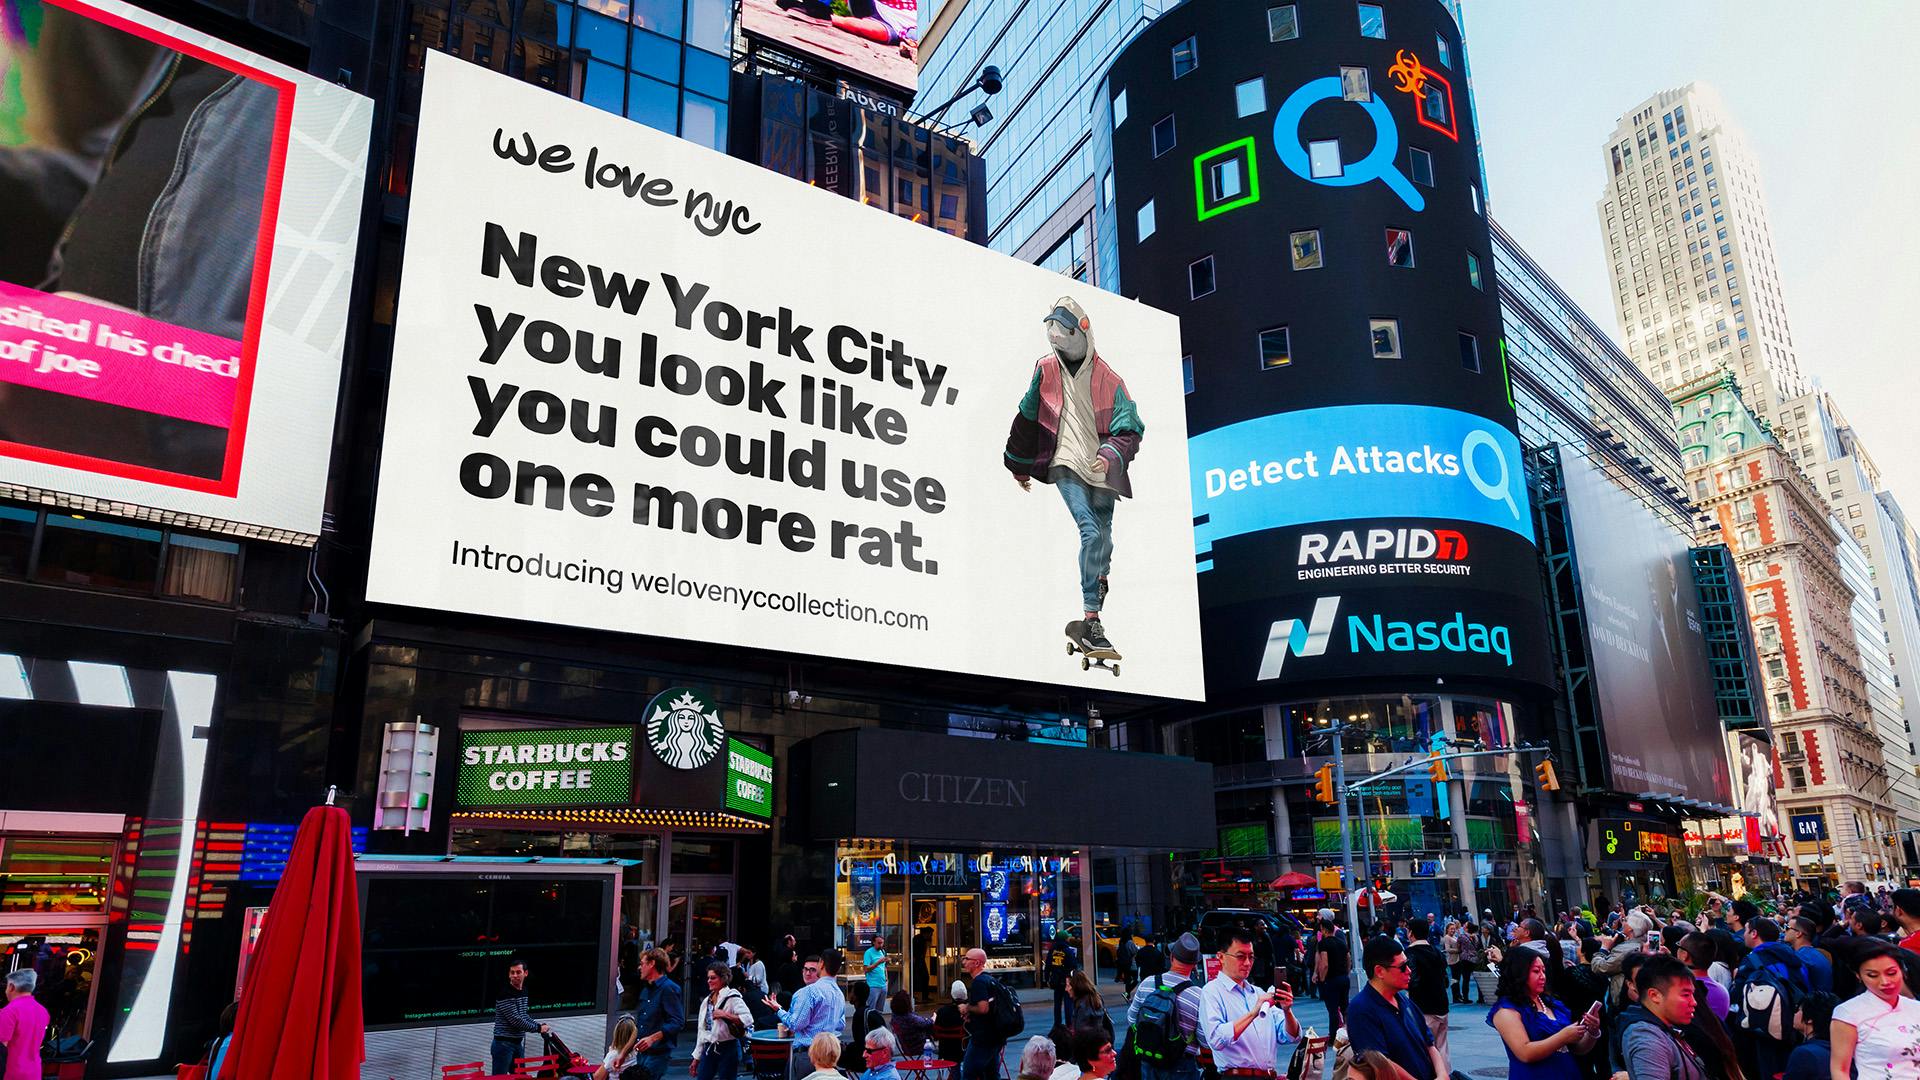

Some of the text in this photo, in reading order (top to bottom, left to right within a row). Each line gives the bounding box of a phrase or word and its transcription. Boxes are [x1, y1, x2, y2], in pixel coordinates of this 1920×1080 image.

[493, 128, 761, 236] we love nyc
[481, 222, 958, 406] New York City,
[35, 345, 102, 378] joe
[96, 323, 147, 357] his
[474, 304, 907, 445] you look like
[467, 375, 946, 514] you could use
[1205, 445, 1460, 499] Detect Attacks
[460, 453, 938, 575] one more rat.
[452, 540, 929, 631] Introducing welovenyccollection.com
[1298, 563, 1471, 580] ENGINEERING BETTER SECURITY
[1348, 612, 1513, 666] Nasdaq
[464, 742, 628, 765] STARBUCKS
[488, 769, 592, 791] COFFEE
[899, 771, 1029, 807] CITIZEN
[1799, 821, 1818, 834] GAP
[924, 873, 968, 887] CITIZEN
